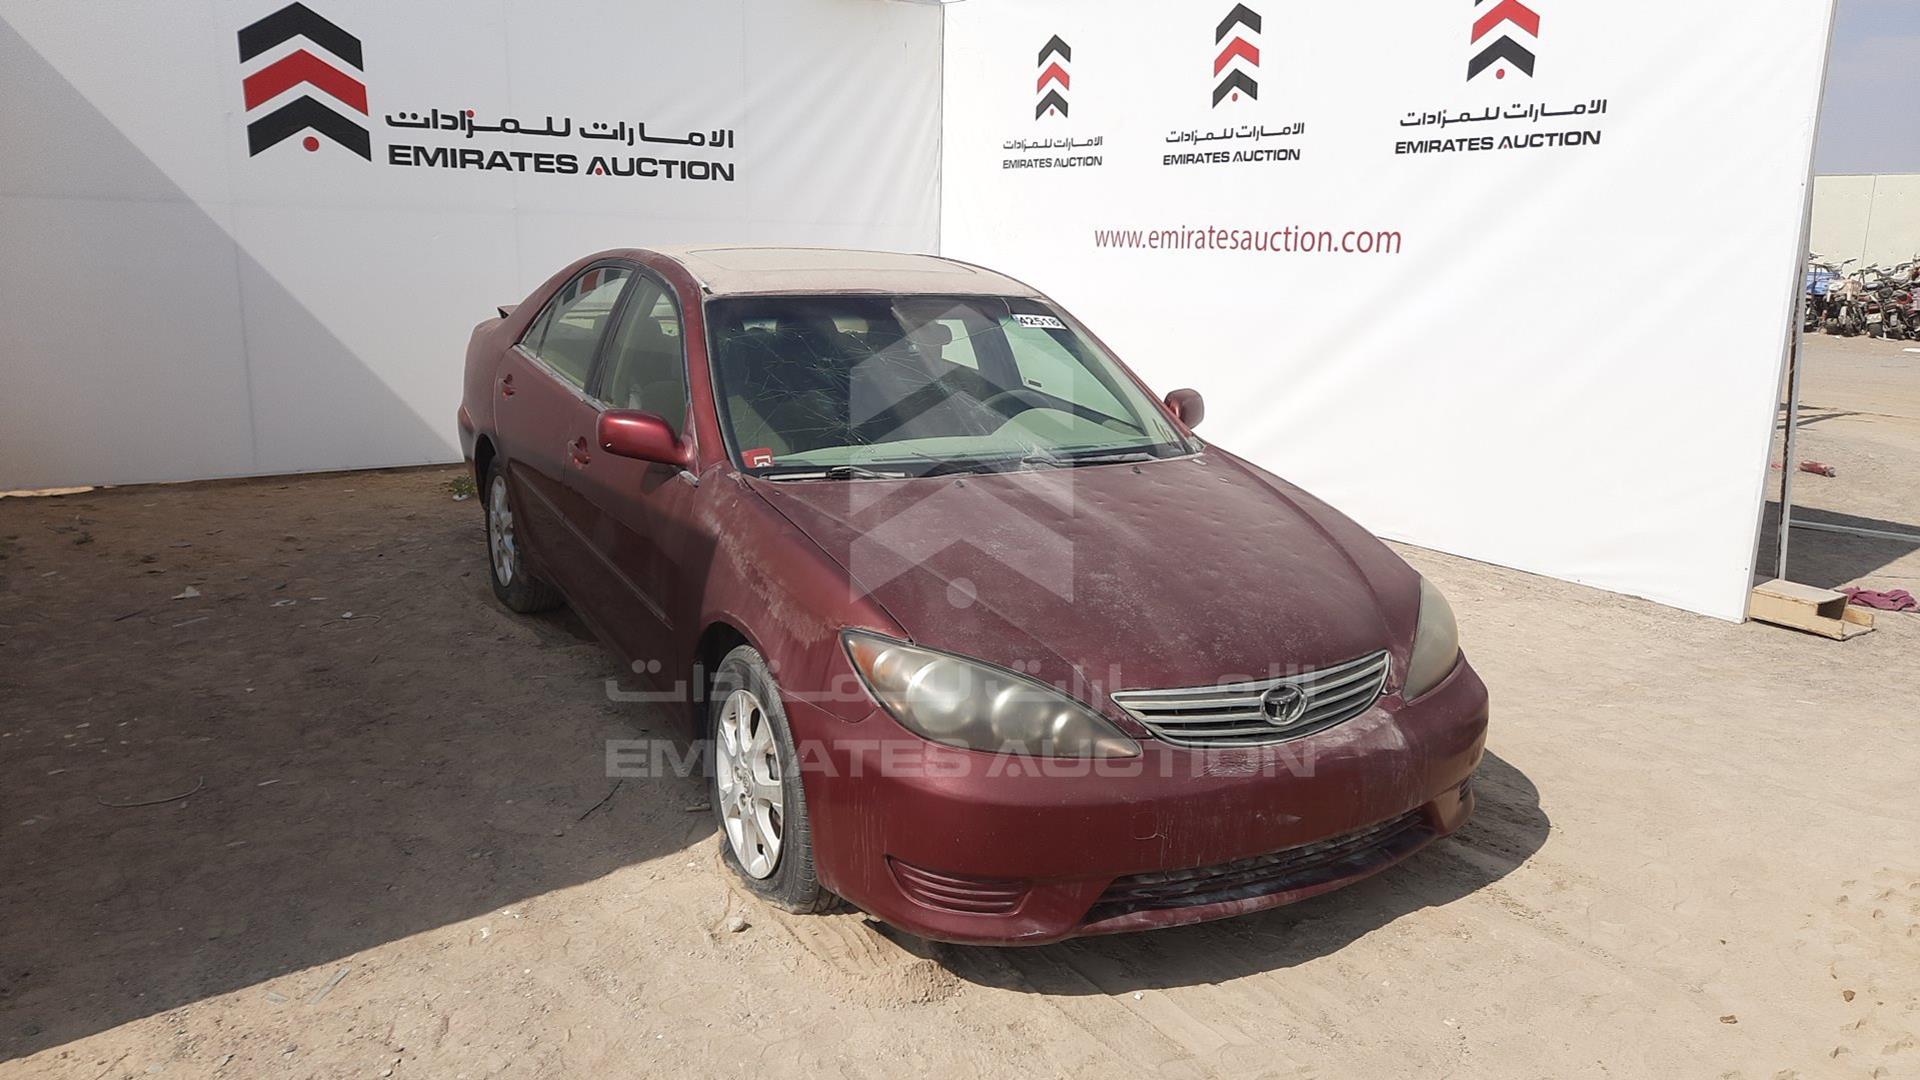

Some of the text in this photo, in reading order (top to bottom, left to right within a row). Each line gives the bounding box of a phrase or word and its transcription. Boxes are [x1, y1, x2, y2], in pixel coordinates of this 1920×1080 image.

[1394, 130, 1602, 155] EMIRATES AUCTION
[387, 143, 735, 182] EMIRATES AUCTION
[1002, 155, 1103, 170] EMIRATES AUCTION
[1162, 148, 1301, 166] EMIRATES AUCTION
[1094, 225, 1402, 254] www.emiratesauction.com
